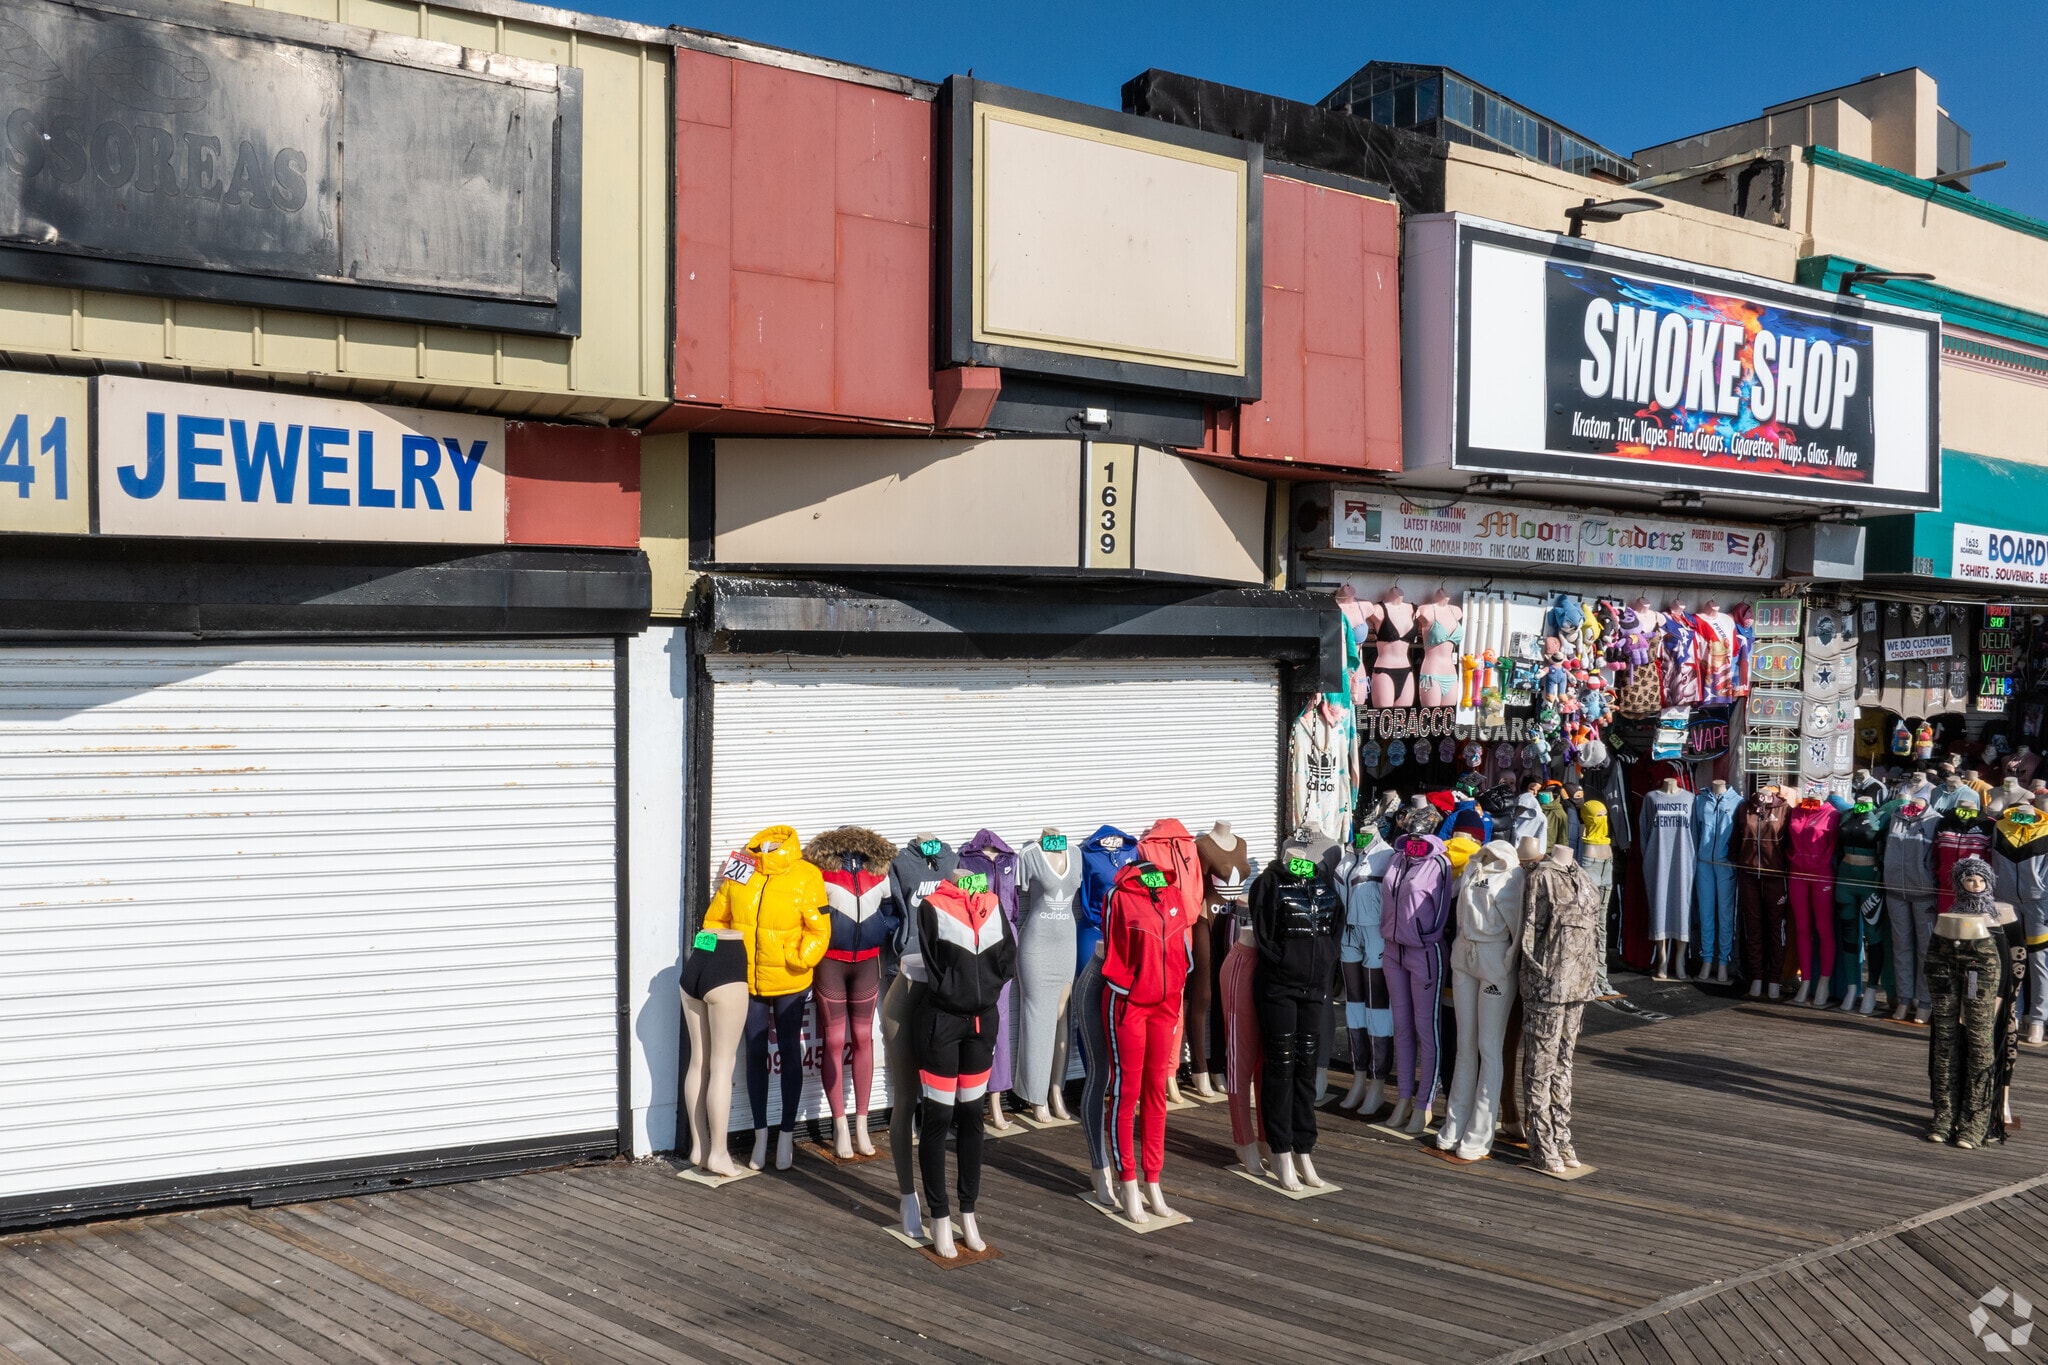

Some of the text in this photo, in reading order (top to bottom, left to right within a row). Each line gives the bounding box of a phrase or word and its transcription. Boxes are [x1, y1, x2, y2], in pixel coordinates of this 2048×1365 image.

[1579, 297, 1859, 431] SMOKE SHOP
[1571, 411, 1857, 468] Kratom THC Vapes Fine Cigars Cigarettes Wraps Glass More
[116, 411, 488, 512] JEWELRY
[1100, 461, 1118, 554] 1639
[1399, 502, 1466, 520] CUSTOM RINTING
[1403, 517, 1462, 534] LATEST FASHION
[1473, 510, 1686, 552] Moon Traders
[1691, 528, 1725, 541] PUERTO RICO
[1965, 537, 1979, 548] 1635
[1390, 535, 1423, 552] TOBACCO
[1430, 539, 1460, 555] HOOKAH
[1463, 541, 1483, 556] PIPES
[1489, 543, 1505, 558] FINE
[1536, 547, 1555, 562] MENS
[1619, 554, 1633, 567] SALT
[1634, 555, 1654, 568] WATER
[1655, 556, 1673, 569] TAFFY
[1676, 558, 1688, 570] CELL
[1690, 558, 1709, 572] PHONE
[1710, 560, 1744, 574] ACCESSORIES
[1699, 542, 1715, 552] ITEMS
[1960, 547, 1983, 556] BOARDWALK
[1988, 533, 2048, 566] BOARD
[1960, 563, 1990, 579] T-SHIRTS
[1995, 567, 2034, 584] SOUVENIRS
[1990, 617, 2005, 628] SHOP
[1886, 636, 1951, 651] WE DO CUSTOMIZE
[1981, 632, 2010, 649] DELTA
[1891, 647, 1948, 659] CHOOSE YOUR PRINT
[1751, 655, 1801, 671] TOBACCO
[1982, 654, 2013, 672] VAPE
[1927, 672, 1944, 686] THIS
[1950, 671, 1965, 684] THIS
[1751, 697, 1801, 716] CIGARS
[1367, 706, 1456, 740] TOBACCO
[1746, 741, 1799, 754] SMOKE SHOP
[1761, 756, 1785, 767] OPEN
[917, 880, 942, 896] NIK
[1861, 892, 1881, 915] NIKE
[1040, 910, 1070, 920] adidas
